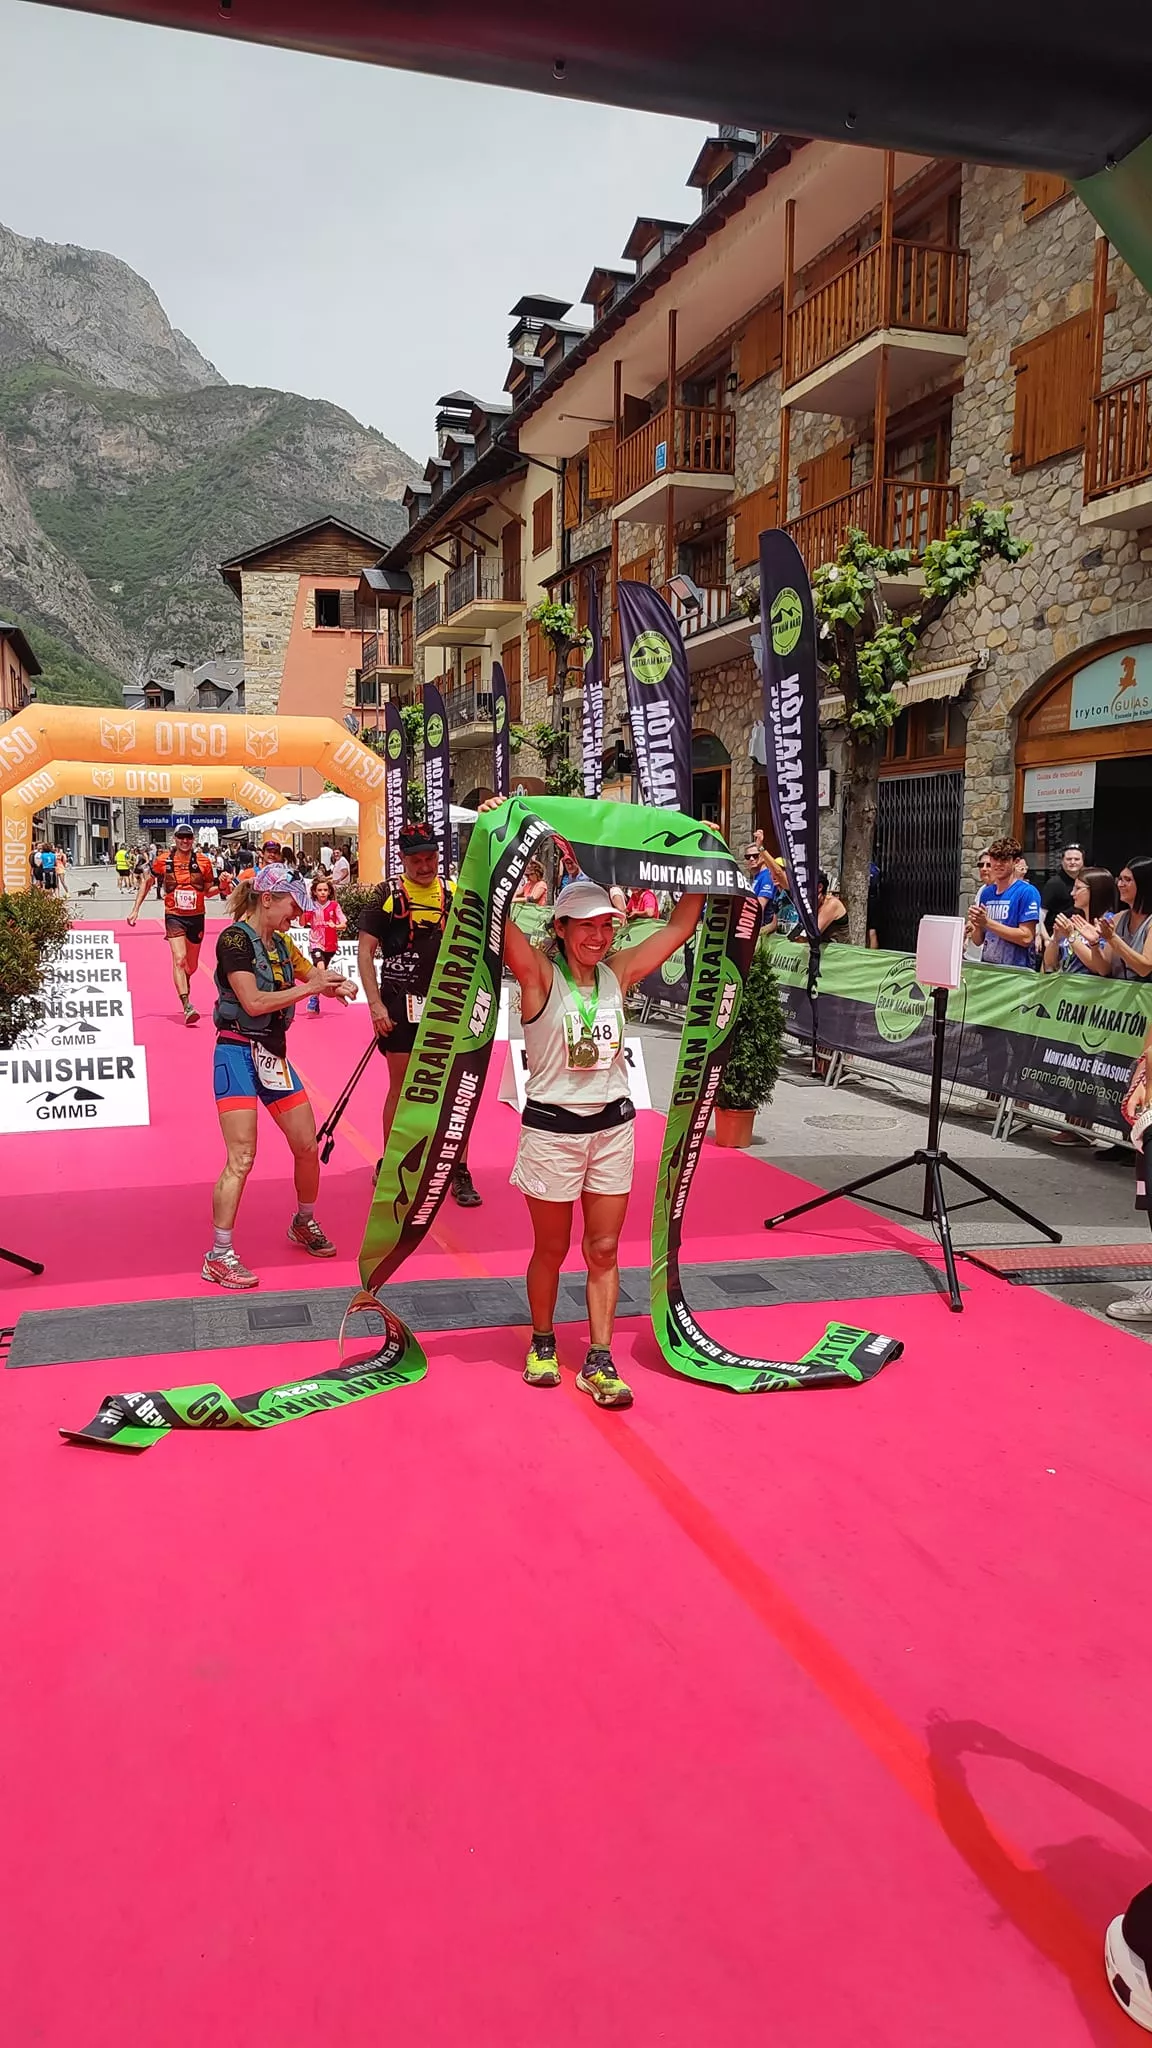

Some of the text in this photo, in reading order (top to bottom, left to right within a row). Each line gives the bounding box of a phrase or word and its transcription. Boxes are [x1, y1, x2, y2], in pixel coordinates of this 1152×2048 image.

[1075, 704, 1109, 719] tryton
[155, 721, 228, 759] OTSO
[126, 769, 171, 793] OTSO
[332, 740, 385, 788] OTSO
[18, 771, 55, 805] OTSO
[239, 781, 277, 809] OTSO
[142, 816, 223, 824] montaña ski camisetas
[5, 842, 27, 889] OTSO
[507, 855, 525, 880] DE
[639, 860, 712, 886] MONTAÑAS
[716, 870, 734, 887] DE
[405, 889, 487, 1104] GRAN MARATÓN
[467, 987, 493, 1039] 42K
[673, 899, 731, 1106] GRAN MARATÓN
[715, 983, 738, 1030] 42K
[1056, 999, 1147, 1038] GRAN MARATÓN
[51, 1034, 96, 1046] GMMB
[258, 1055, 277, 1070] 787
[1043, 1048, 1132, 1083] MONTAÑAS DE BENASQUE
[36, 1104, 97, 1120] GMMB
[694, 1064, 722, 1130] BENASQUE
[411, 1070, 479, 1226] MONTAÑAS DE BENASQUE
[690, 1131, 703, 1149] DE
[674, 1301, 723, 1358] BENASQUE
[720, 1353, 740, 1364] DE
[338, 1370, 411, 1397] GRAN
